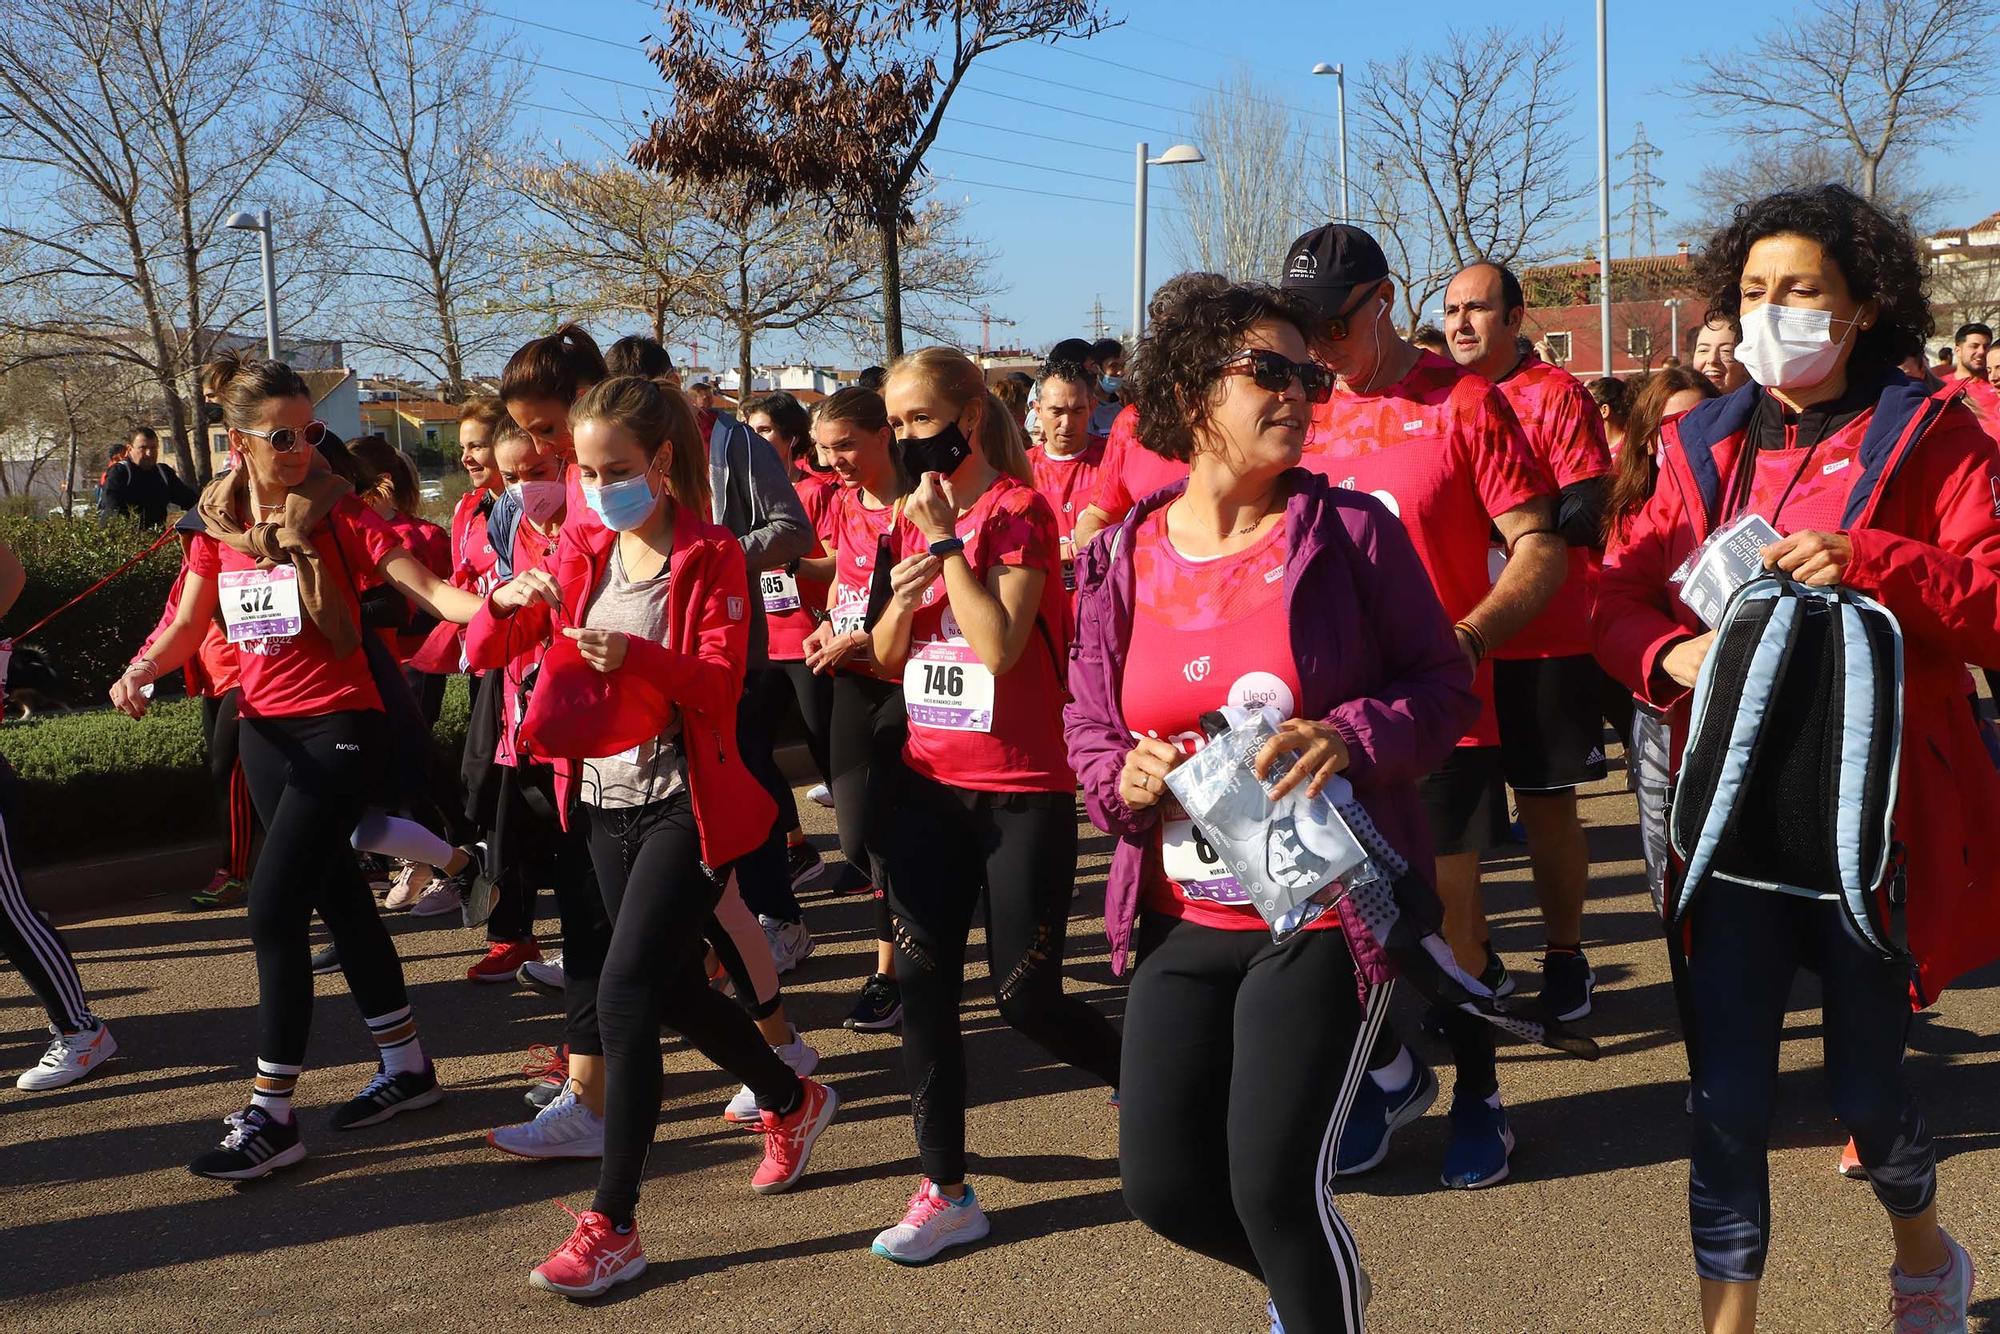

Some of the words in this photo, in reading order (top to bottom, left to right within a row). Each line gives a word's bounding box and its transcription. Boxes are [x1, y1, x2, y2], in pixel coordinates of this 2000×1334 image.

[1735, 534, 1764, 561] HIGIEN
[1743, 527, 1767, 549] MASC
[761, 576, 784, 594] 385
[240, 586, 273, 613] 572
[924, 664, 964, 697] 746
[1242, 689, 1277, 703] Llegó
[335, 743, 360, 751] NASA
